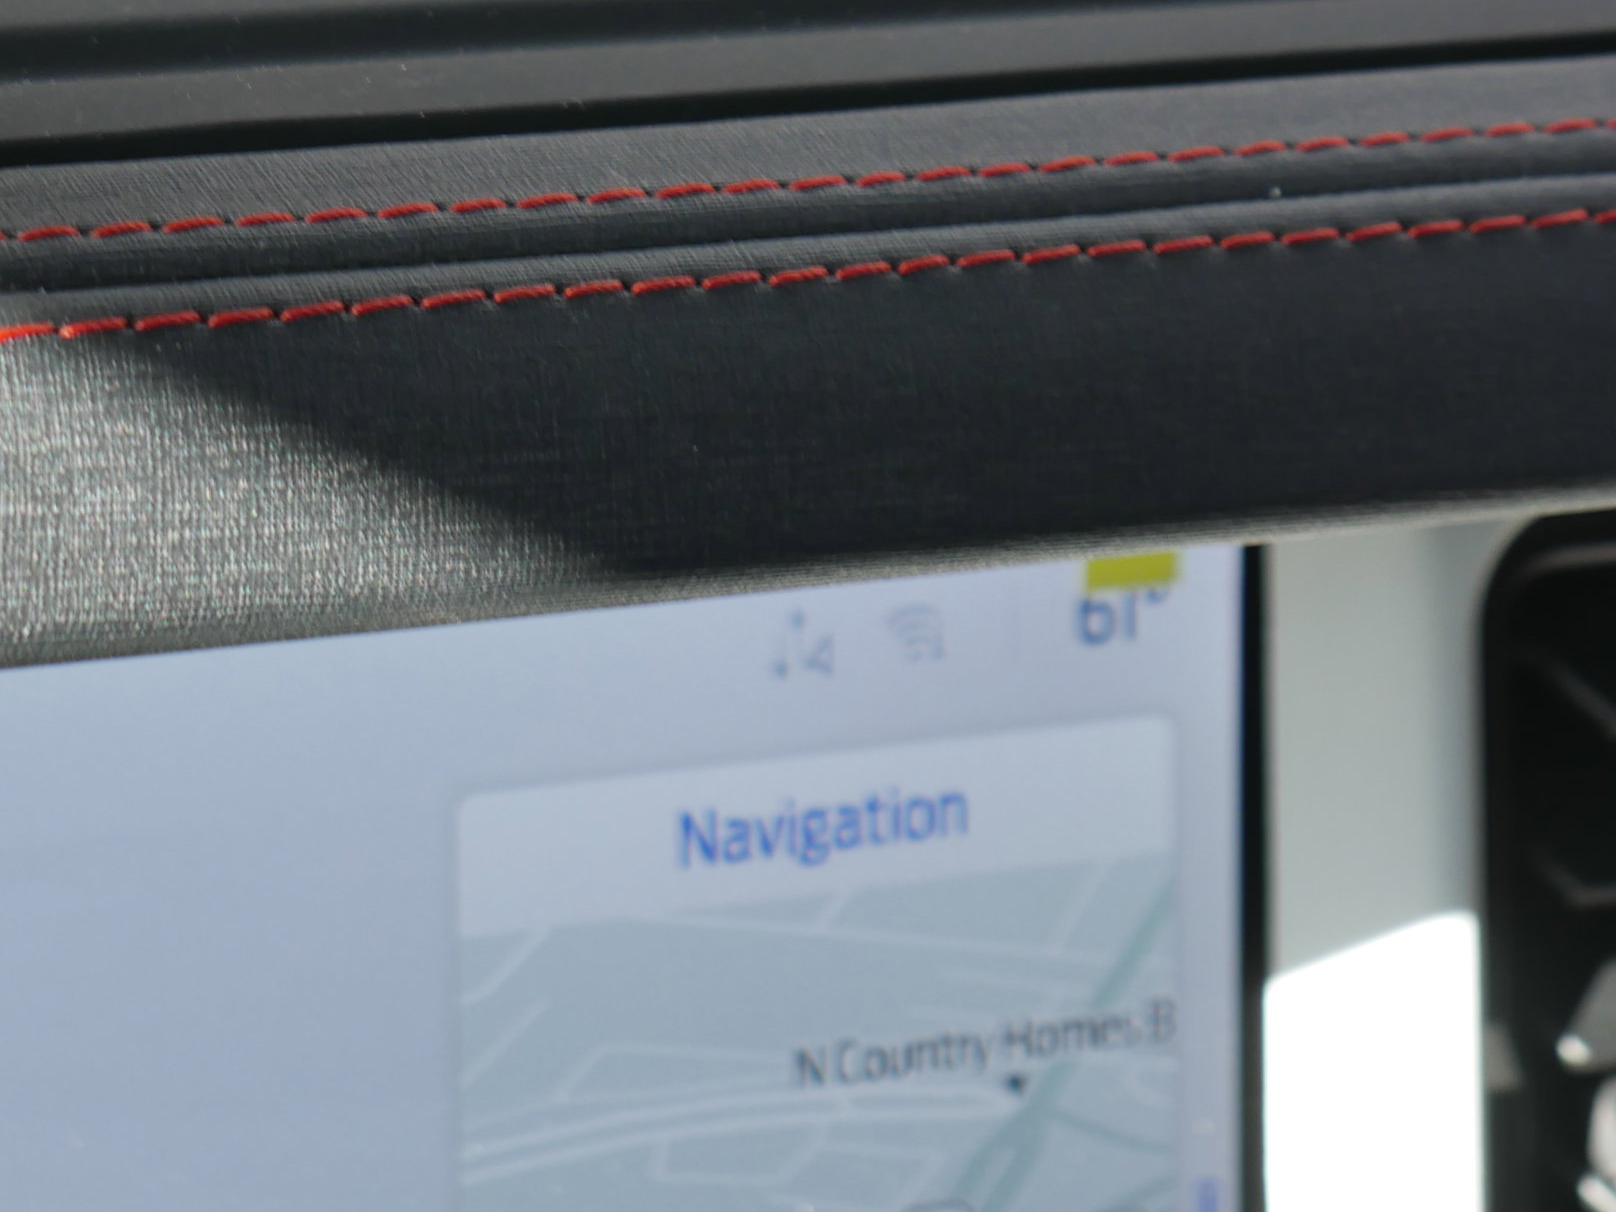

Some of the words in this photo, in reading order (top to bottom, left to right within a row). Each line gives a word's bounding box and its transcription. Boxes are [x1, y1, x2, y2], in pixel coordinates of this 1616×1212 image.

[676, 787, 970, 868] Navigation
[793, 1043, 828, 1086] N
[837, 1028, 991, 1084] Country
[1001, 1012, 1141, 1056] Homes
